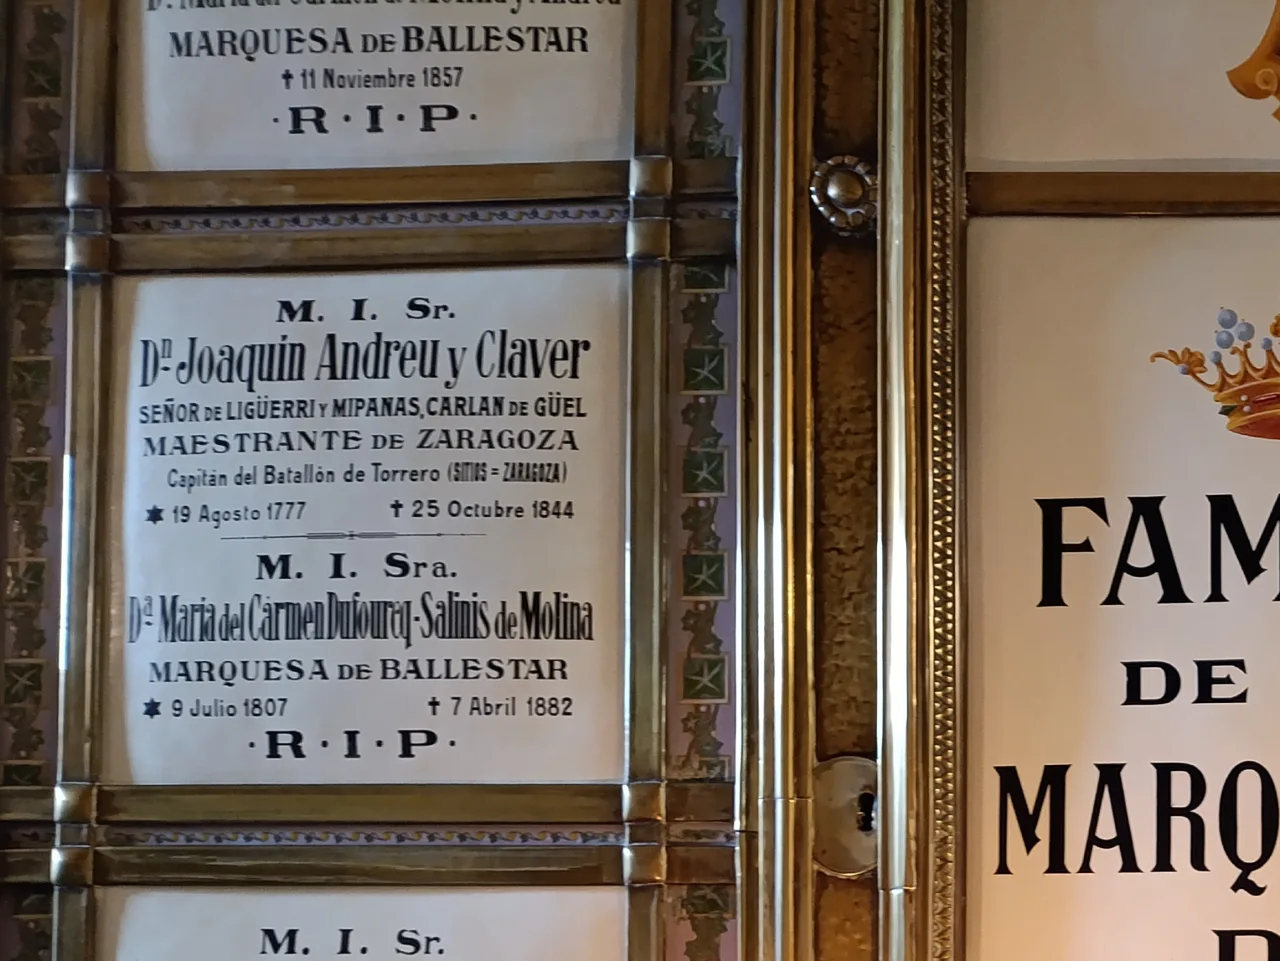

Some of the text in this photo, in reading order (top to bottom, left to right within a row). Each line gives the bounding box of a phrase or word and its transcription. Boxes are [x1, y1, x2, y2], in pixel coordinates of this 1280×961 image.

[170, 26, 588, 62] MARQUESA DE BALLESTAR
[300, 67, 463, 89] 11 Noviembre 1857
[406, 298, 455, 319] Sr.
[315, 330, 591, 380] Andreu Claver
[140, 392, 587, 424] SEÑOR DE LIGÜERRI DE GÜEL
[144, 429, 579, 455] MAESTRANTE DE ZARAGOZA
[234, 466, 256, 485] del
[264, 464, 334, 484] Batallón
[344, 463, 365, 482] de
[371, 463, 440, 482] Torrero
[173, 500, 574, 529] 19 Agosto 1777 25 Octubre 1844
[384, 553, 456, 577] Sra.
[219, 591, 594, 641] del de Molina
[150, 659, 567, 687] MARQUESA DE BALLESTAR
[1120, 659, 1248, 705] DE
[190, 697, 572, 717] Julio 1807 Abril 1882
[396, 929, 444, 955] Sr.
